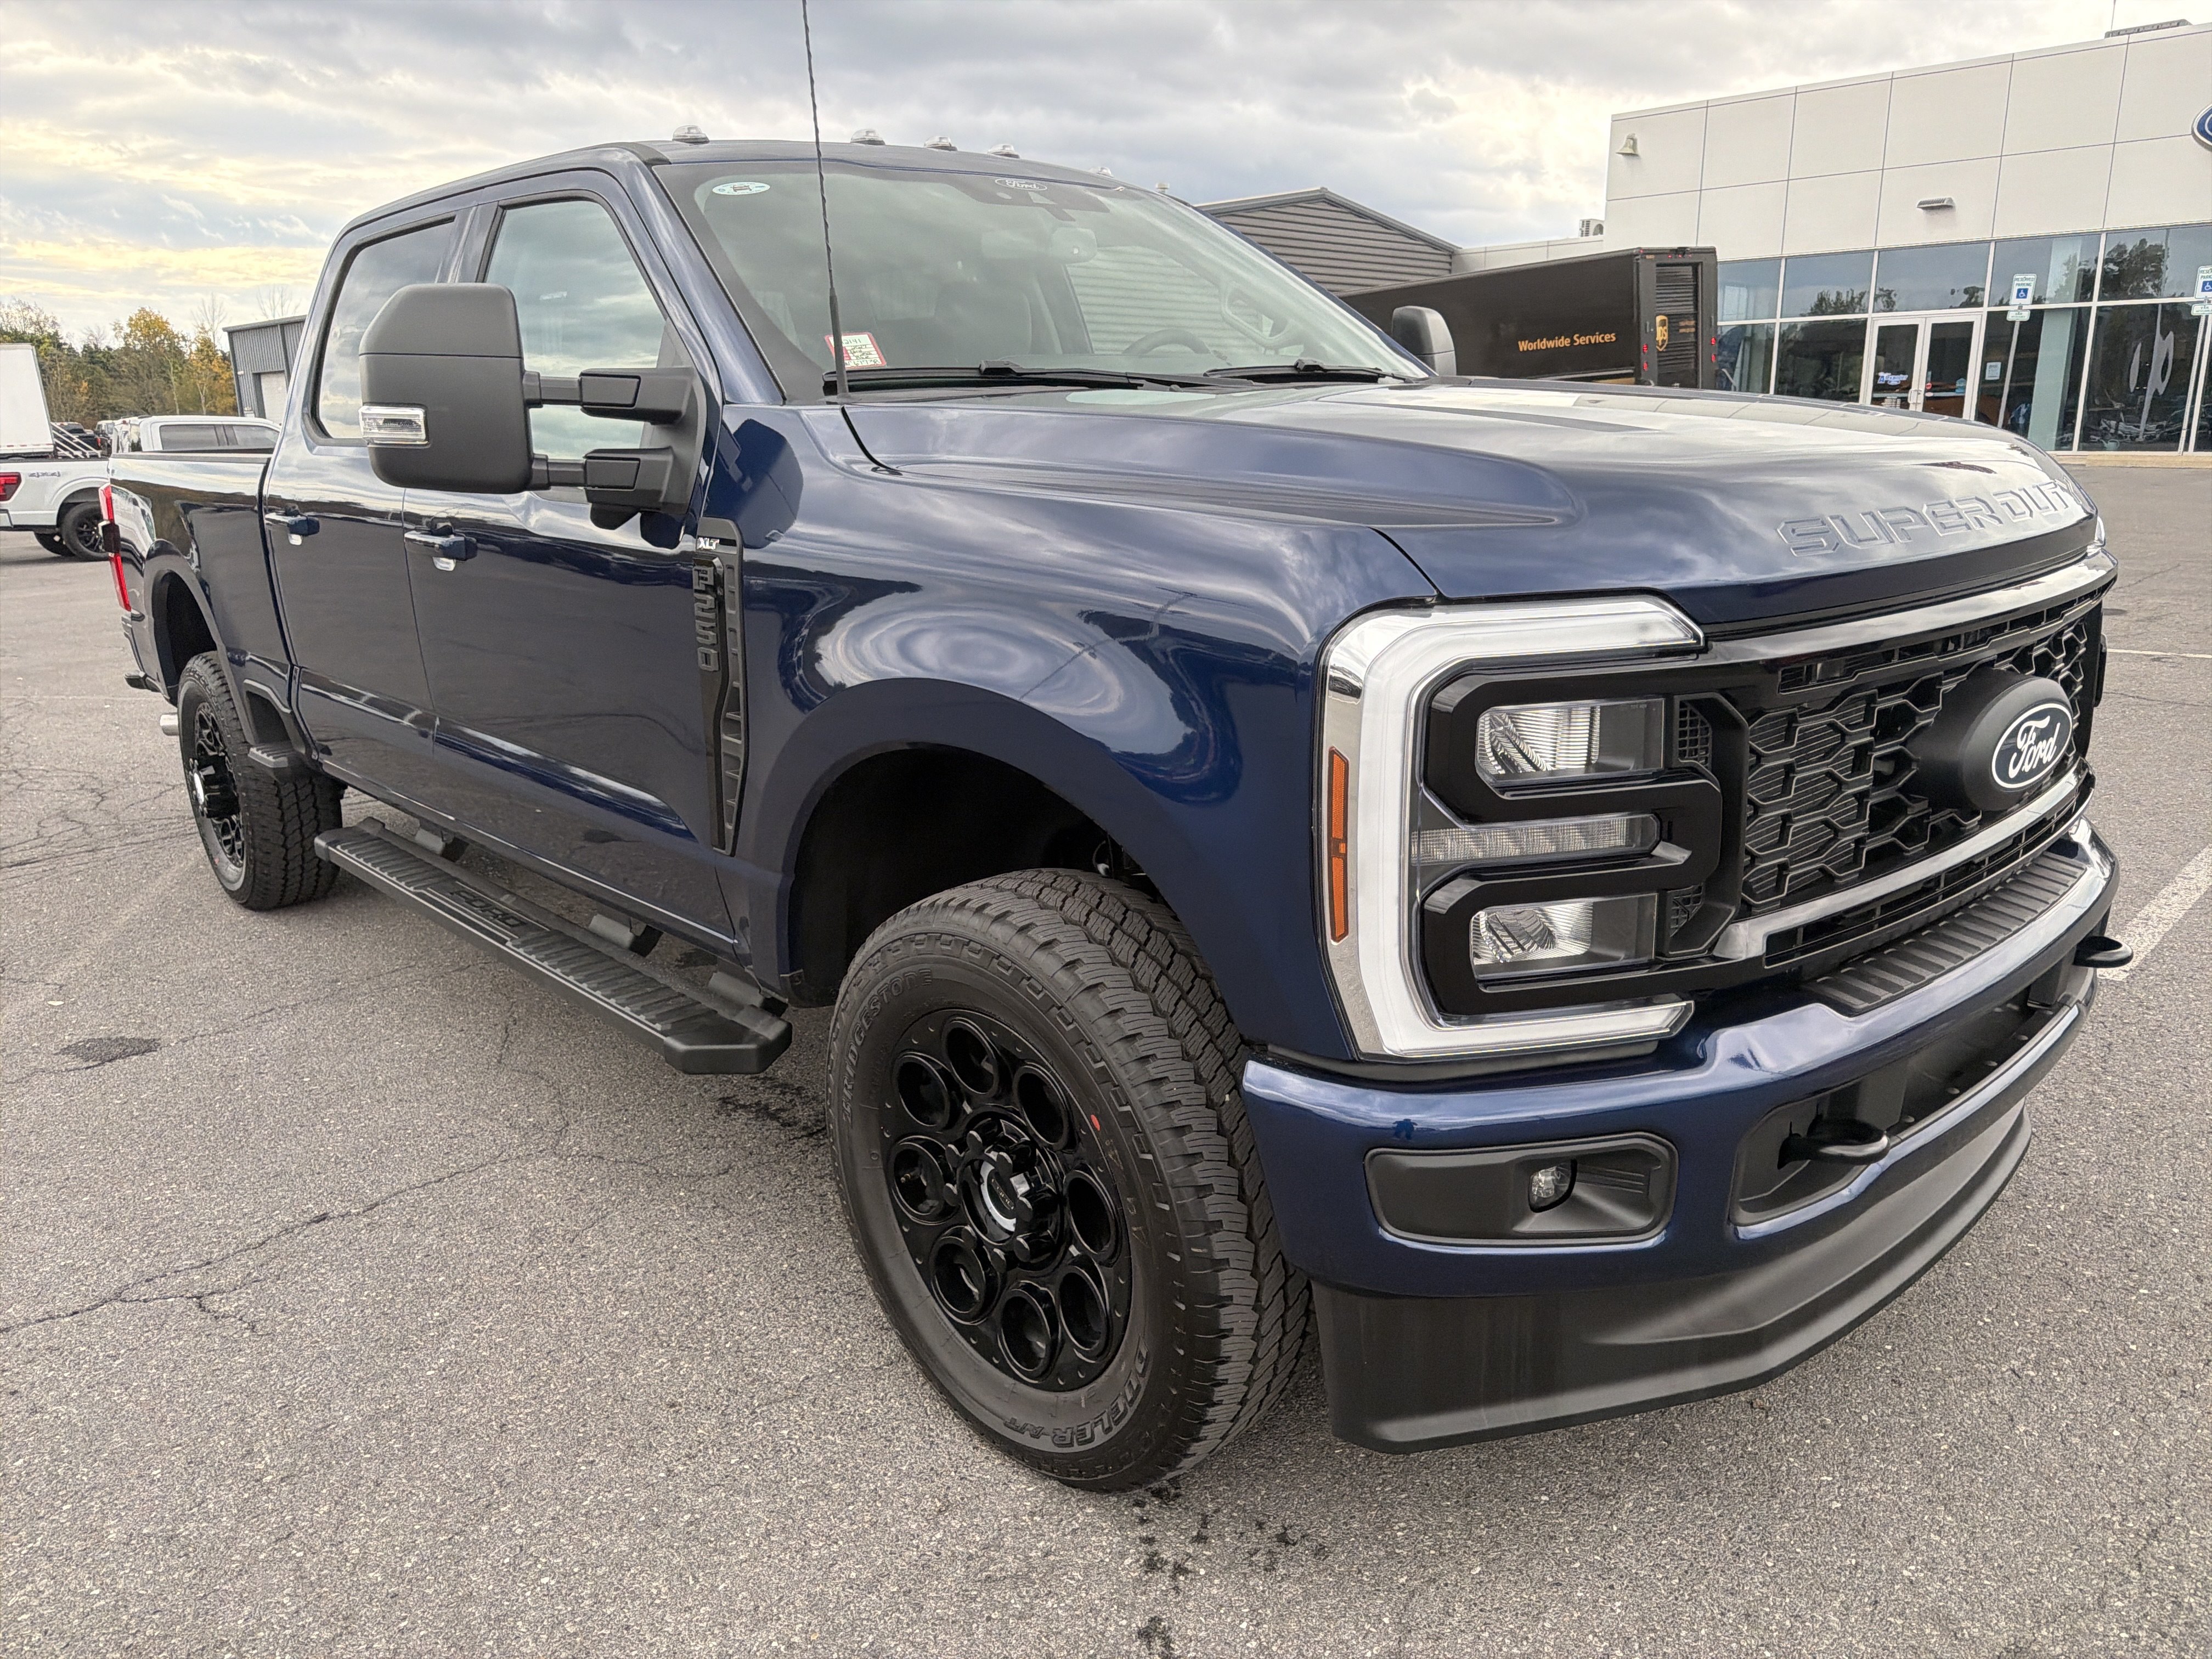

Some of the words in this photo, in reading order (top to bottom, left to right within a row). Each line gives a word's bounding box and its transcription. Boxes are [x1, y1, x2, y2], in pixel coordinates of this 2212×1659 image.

[1005, 179, 1040, 189] Ford
[1518, 336, 1571, 352] Worldwide
[1573, 331, 1616, 346] Services
[1776, 496, 2004, 557] SUPER
[1992, 476, 2083, 523] DUTY
[696, 537, 720, 550] XLT
[2008, 715, 2061, 778] Ford
[449, 890, 528, 927] FORD
[842, 968, 932, 1124] BRIDGESTONE
[1051, 1335, 1149, 1448] DUELER
